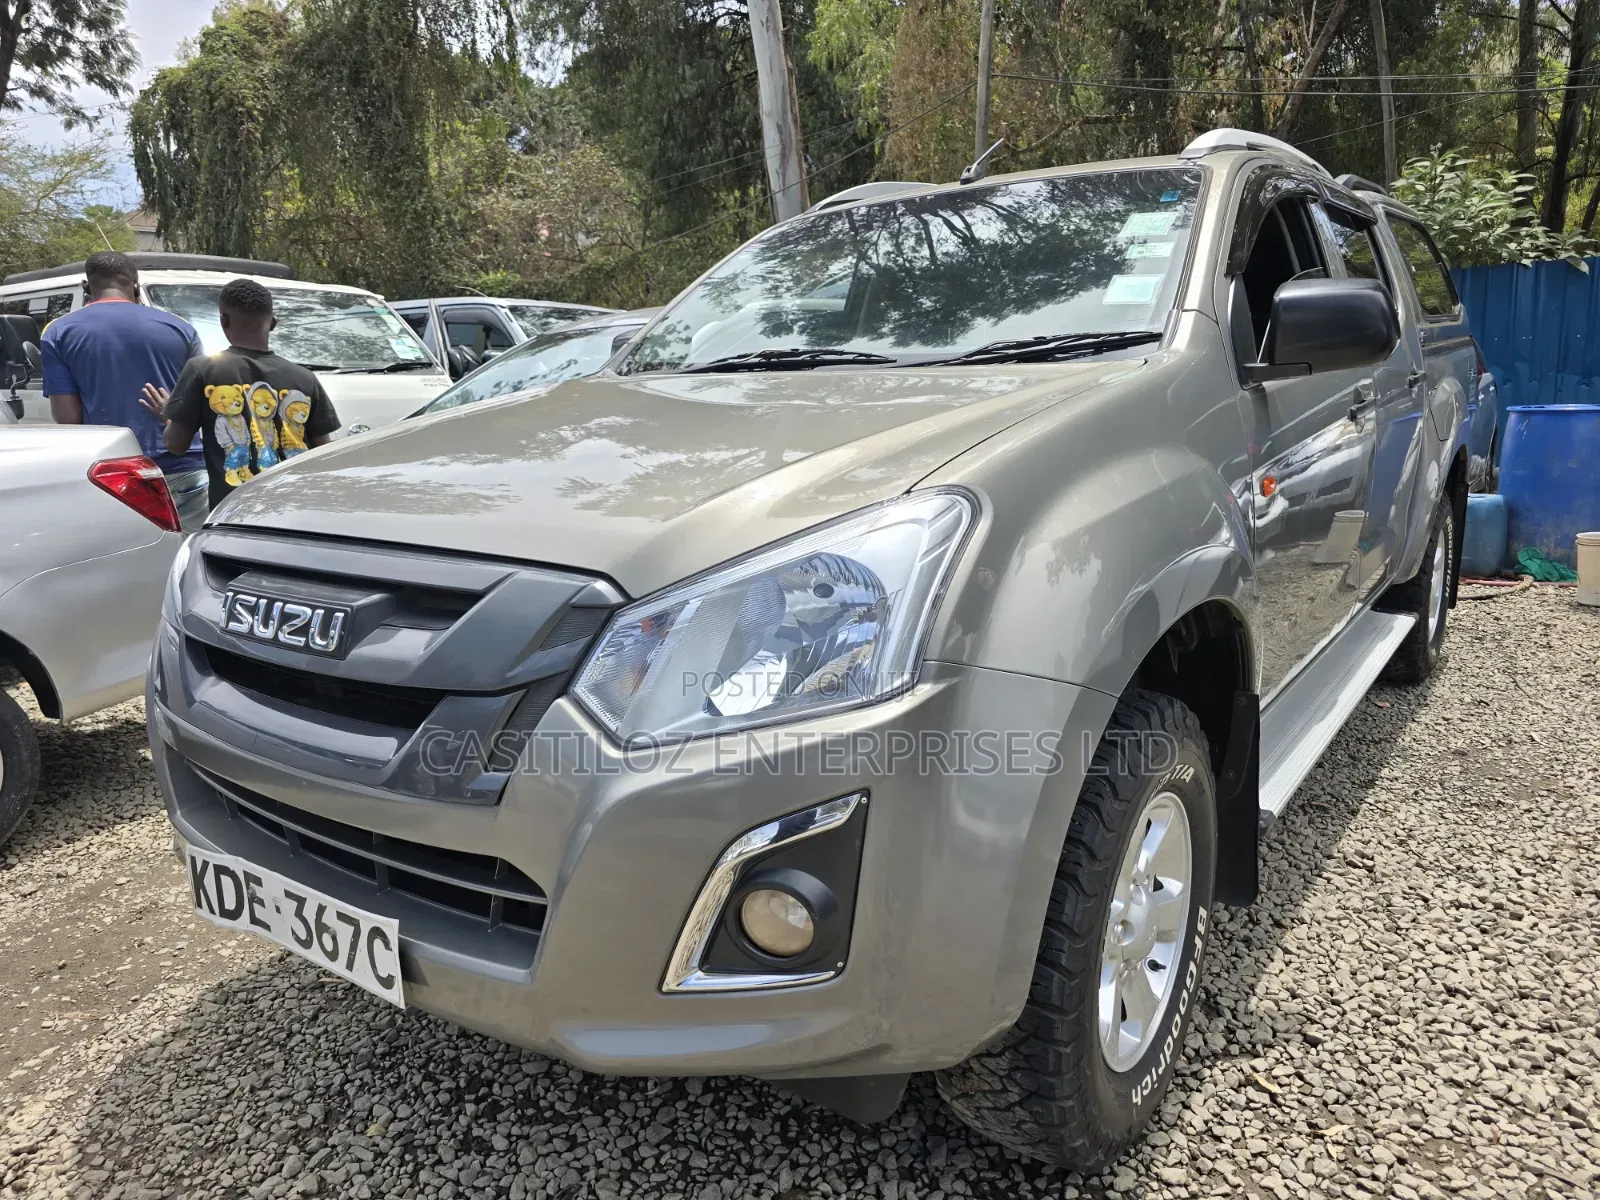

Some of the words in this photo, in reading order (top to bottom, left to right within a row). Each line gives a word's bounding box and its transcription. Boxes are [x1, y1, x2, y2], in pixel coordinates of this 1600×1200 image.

[219, 591, 345, 652] ISUZU
[1170, 764, 1195, 784] T/A
[189, 855, 272, 933] KDE
[283, 887, 397, 991] 367C
